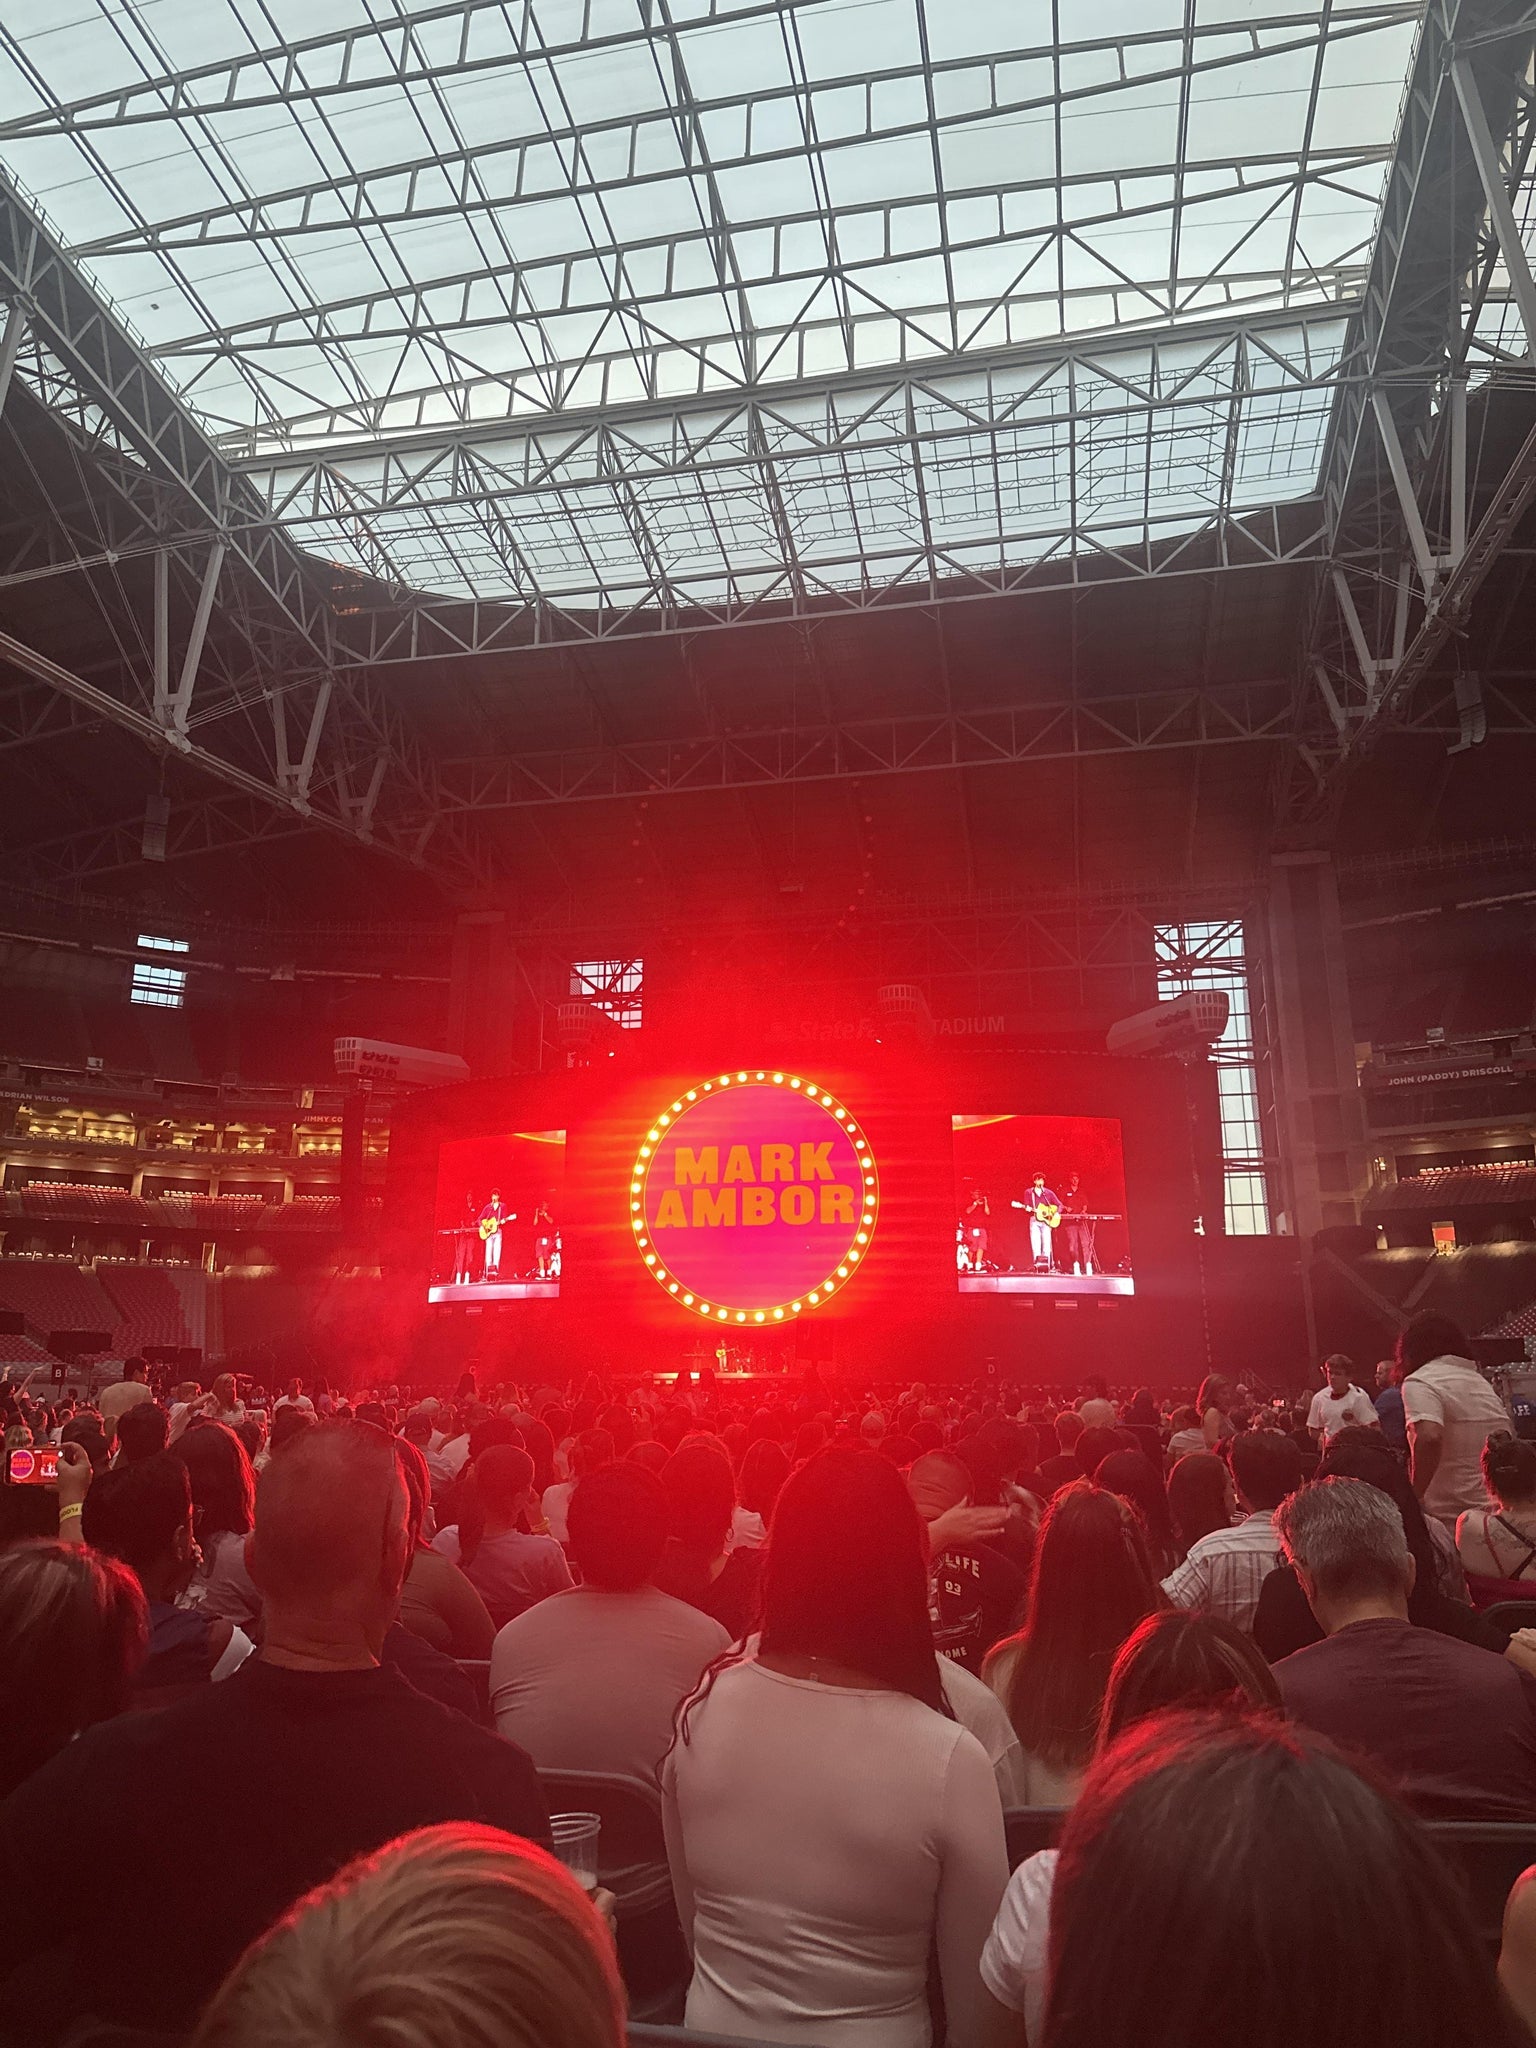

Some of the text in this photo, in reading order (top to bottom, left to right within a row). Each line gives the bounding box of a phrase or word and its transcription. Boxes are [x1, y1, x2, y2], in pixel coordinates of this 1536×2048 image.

[932, 1016, 1005, 1035] TADIUM
[1388, 1065, 1513, 1085] JOHN (PADDY) DRISCOLL
[35, 1095, 70, 1103] WILSON
[674, 1141, 836, 1185] MARK
[654, 1184, 856, 1228] AMBOR
[987, 1363, 996, 1374] D
[941, 1647, 967, 1659] OME
